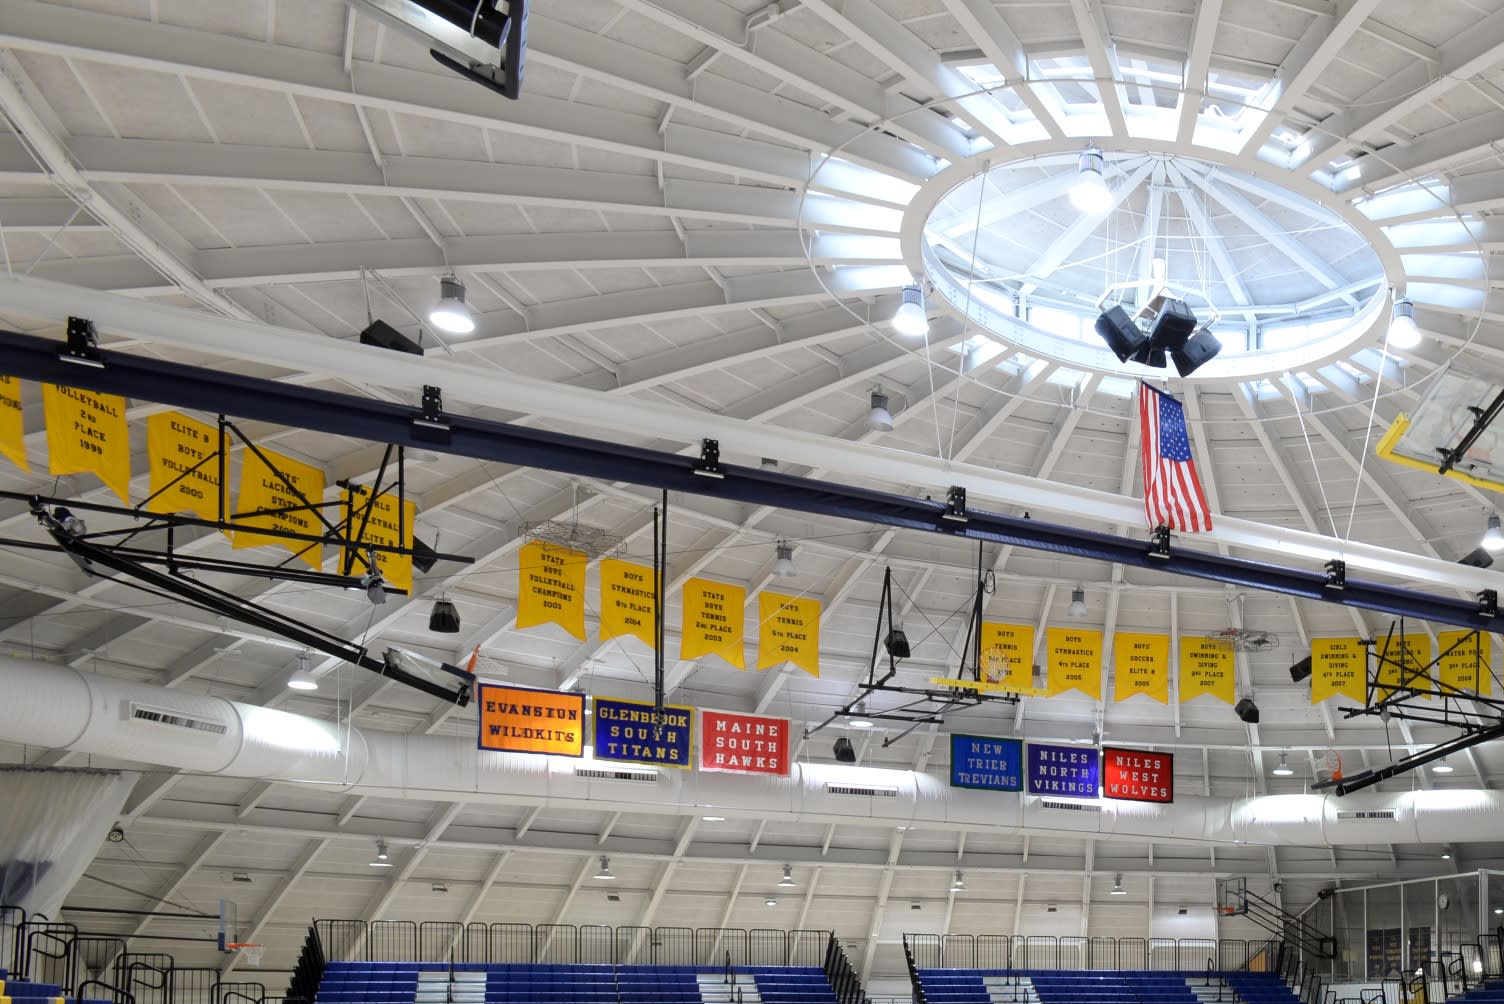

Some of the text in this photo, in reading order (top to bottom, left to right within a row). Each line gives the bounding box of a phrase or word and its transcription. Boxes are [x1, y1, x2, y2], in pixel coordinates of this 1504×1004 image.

[56, 385, 118, 418] VOLLEYBALL
[81, 410, 96, 423] 2ND
[75, 421, 106, 442] PLACE
[171, 421, 198, 439] ELITE
[541, 554, 565, 565] STATE
[544, 566, 562, 576] BOYS
[624, 572, 643, 581] BOYS
[529, 574, 575, 591] VOLLEYBALL
[533, 586, 572, 602] CHAMPIONS
[611, 584, 655, 599] GYMNASTICS
[703, 591, 725, 600] STATE
[630, 604, 651, 614] PLACE
[705, 602, 723, 610] BOYS
[780, 603, 799, 611] BOYS
[701, 612, 726, 622] TENNIS
[777, 617, 803, 626] TENNIS
[710, 625, 732, 633] PLACE
[787, 632, 806, 640] PLACE
[1055, 648, 1093, 656] GYMNASTICS
[486, 700, 577, 721] EVANSTON
[489, 724, 575, 743] WILDKITS
[715, 719, 778, 737] MAINE
[608, 742, 679, 760] TITANS
[715, 737, 777, 753] SOUTH
[972, 743, 1002, 755] NEW
[715, 753, 778, 769] HAWKS
[1040, 750, 1088, 764] NILES
[1116, 756, 1161, 769] NILES
[968, 758, 1007, 771] TRIER
[1039, 765, 1089, 779] NORTH
[1119, 770, 1159, 783] WEST
[958, 772, 1017, 786] TREVIANS
[1034, 780, 1093, 793] VIKINGS
[1110, 783, 1167, 797] WOLVES
